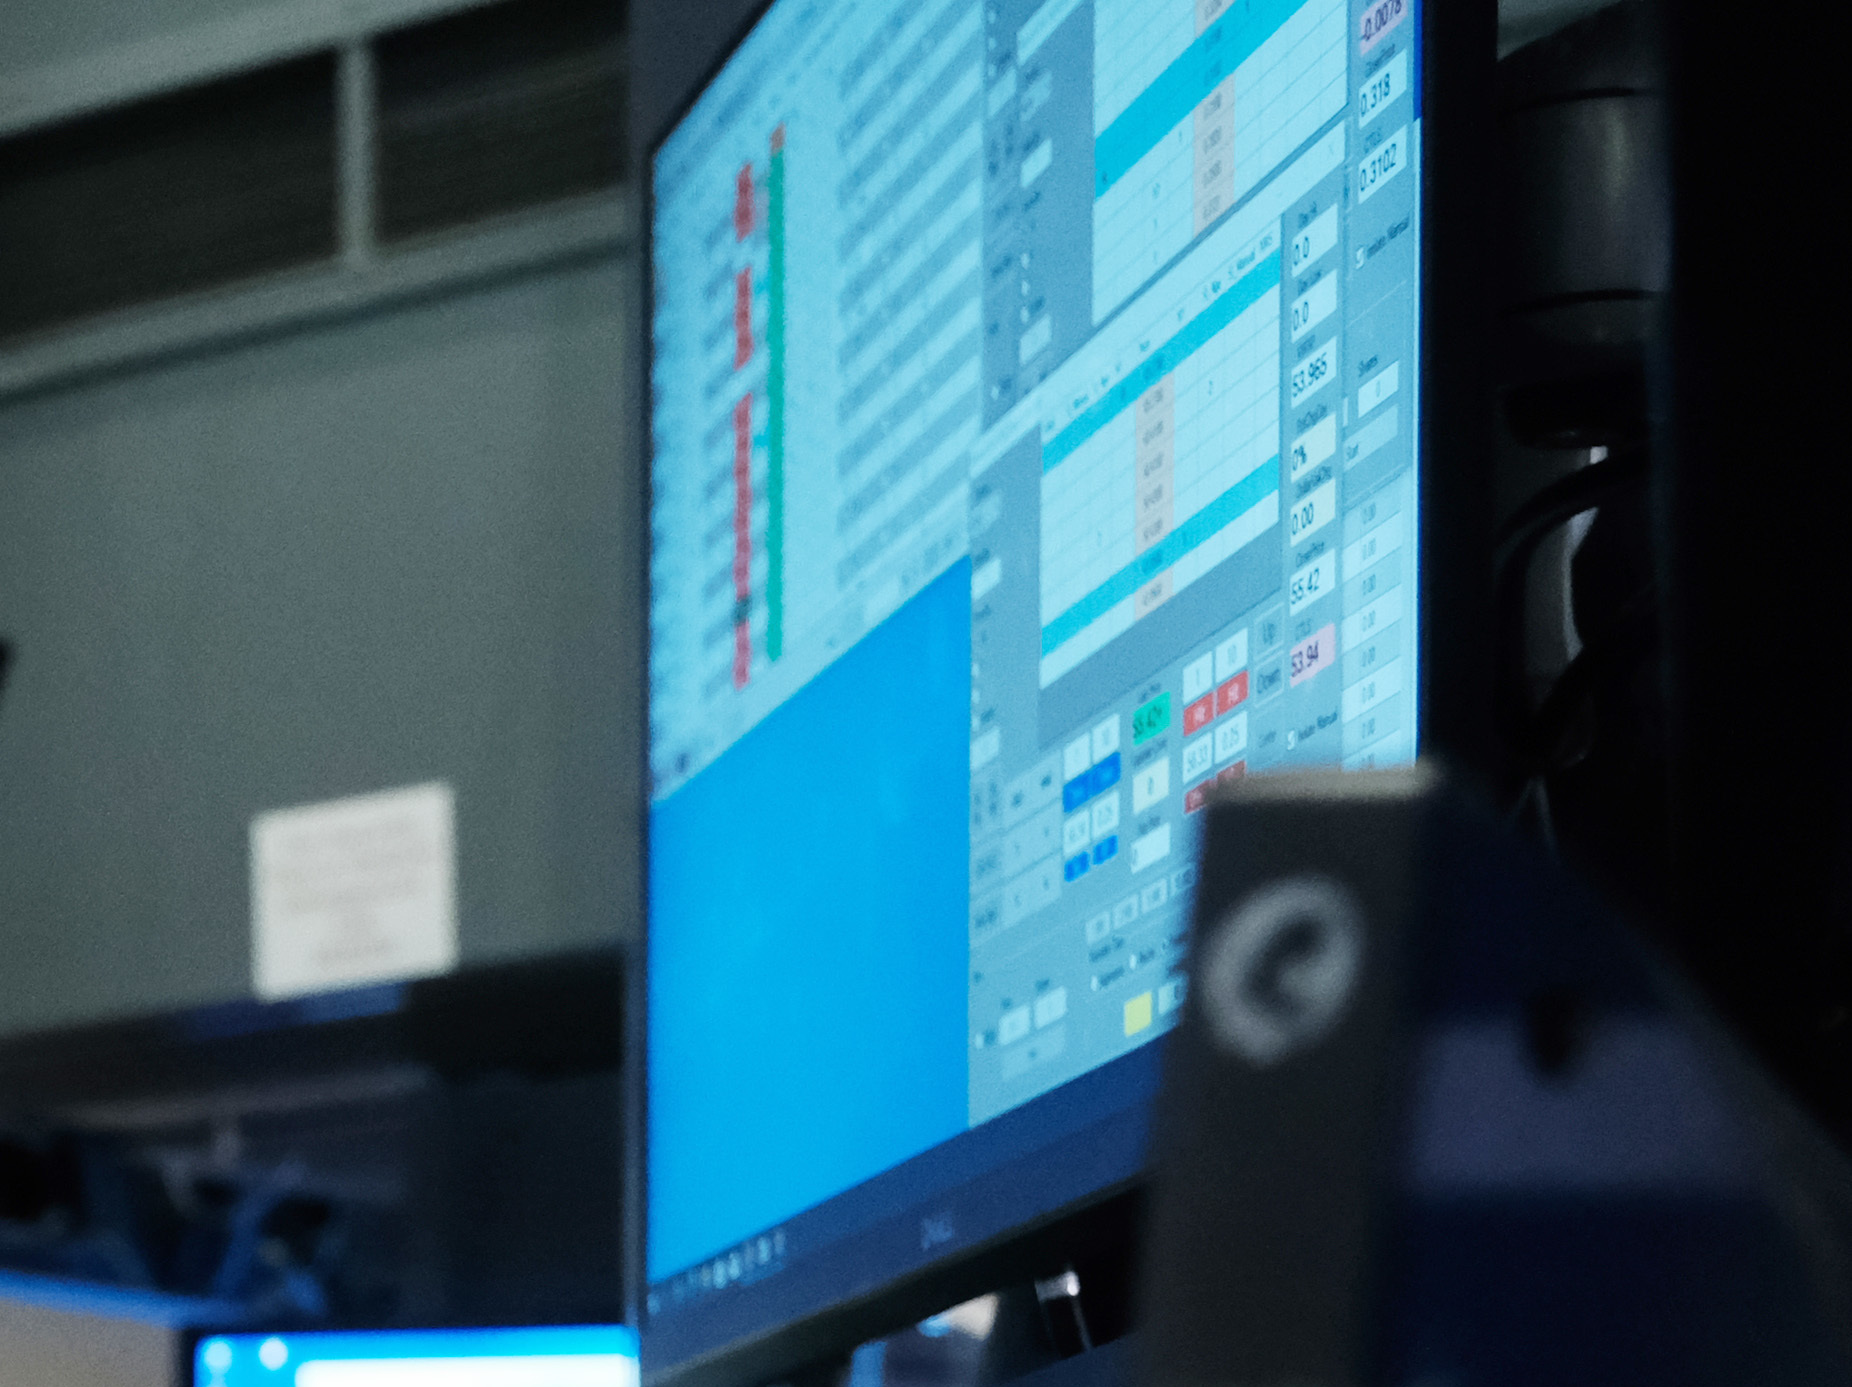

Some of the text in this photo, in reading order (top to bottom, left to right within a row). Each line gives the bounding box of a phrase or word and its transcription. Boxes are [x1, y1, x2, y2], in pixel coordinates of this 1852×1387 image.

[1359, 73, 1391, 118] 0.318
[1359, 143, 1397, 192] 0.3102
[1292, 501, 1315, 537] 0.00
[1291, 566, 1321, 606] 55.42
[1291, 639, 1320, 678] 53.94
